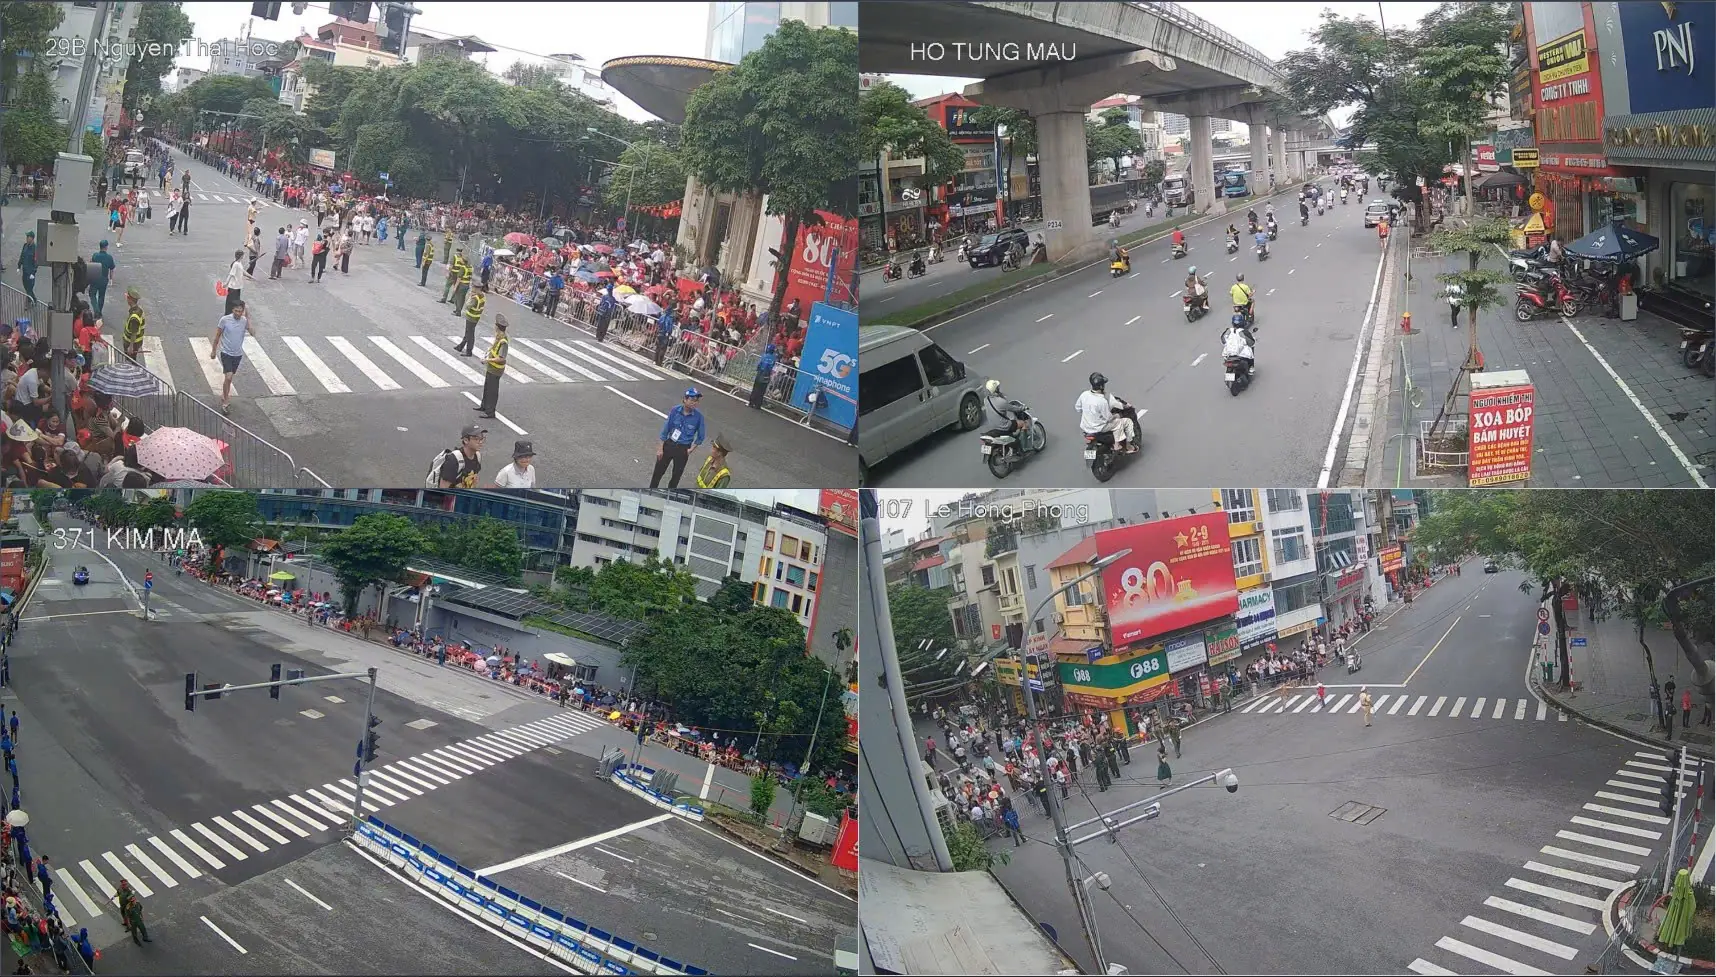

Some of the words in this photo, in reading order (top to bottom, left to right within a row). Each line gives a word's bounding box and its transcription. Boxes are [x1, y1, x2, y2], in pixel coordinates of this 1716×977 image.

[1539, 46, 1563, 61] WESTERN
[1653, 22, 1695, 76] PNJ
[1546, 53, 1565, 66] UNION
[822, 318, 840, 328] VNPT
[1473, 410, 1503, 428] XOA
[1506, 404, 1532, 424] BÓP
[1190, 525, 1208, 542] 2-9
[1121, 561, 1175, 609] 80
[1130, 658, 1160, 679] F88
